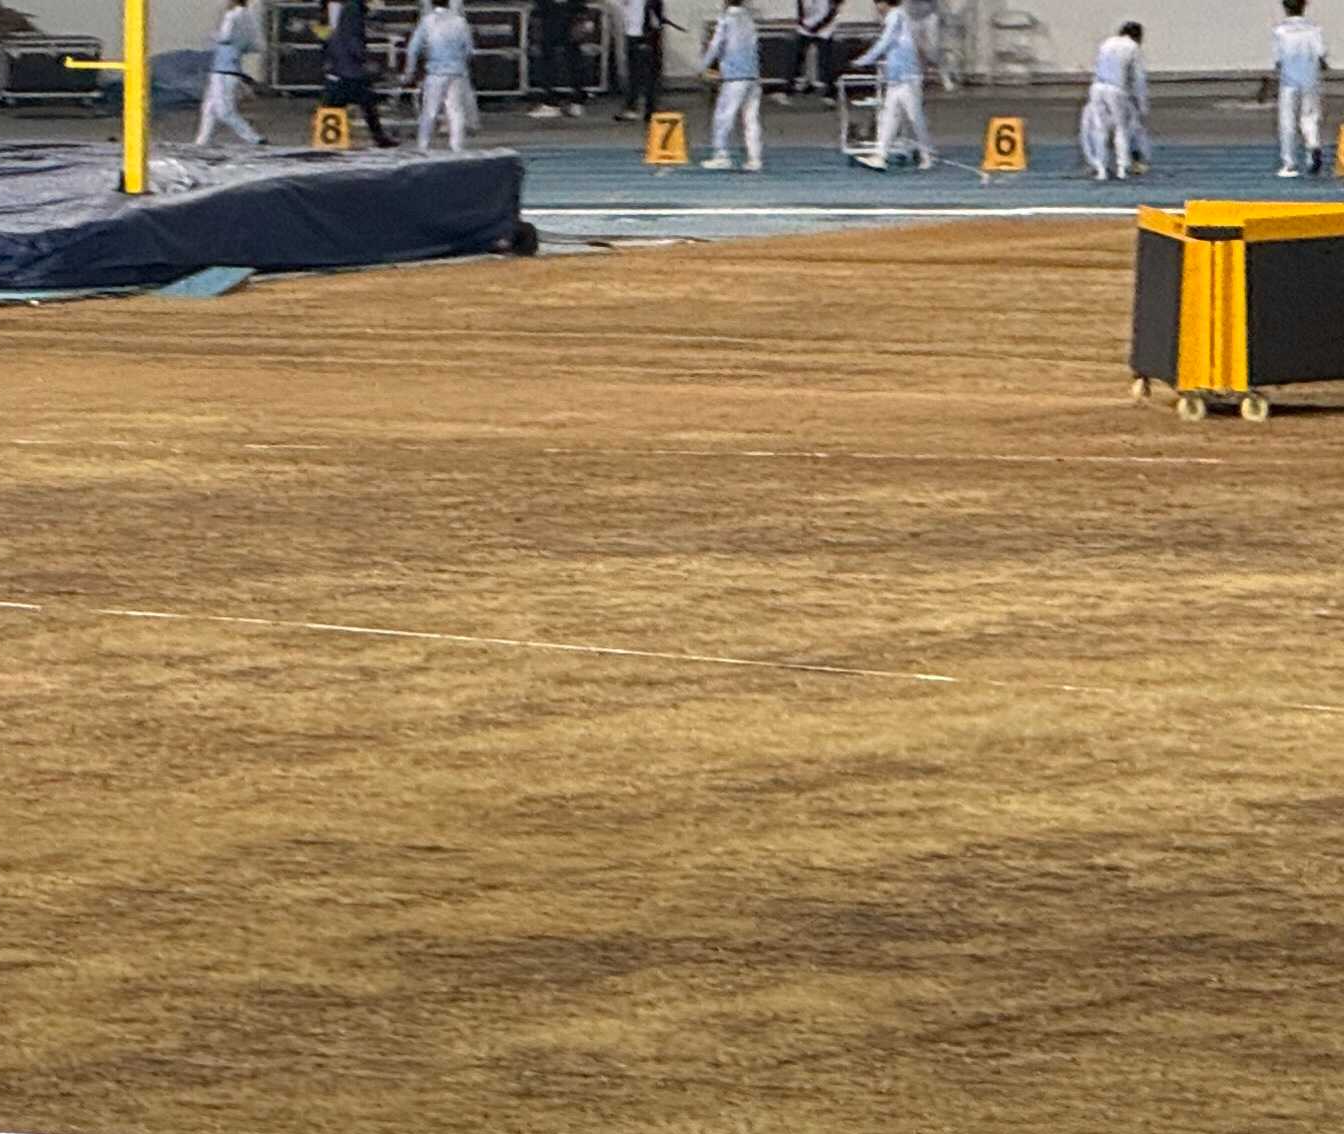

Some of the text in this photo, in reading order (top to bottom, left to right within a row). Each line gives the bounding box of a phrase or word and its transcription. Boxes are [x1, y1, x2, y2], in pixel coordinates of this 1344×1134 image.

[321, 113, 341, 145] 8
[655, 118, 679, 150] 7
[995, 124, 1016, 156] 6
